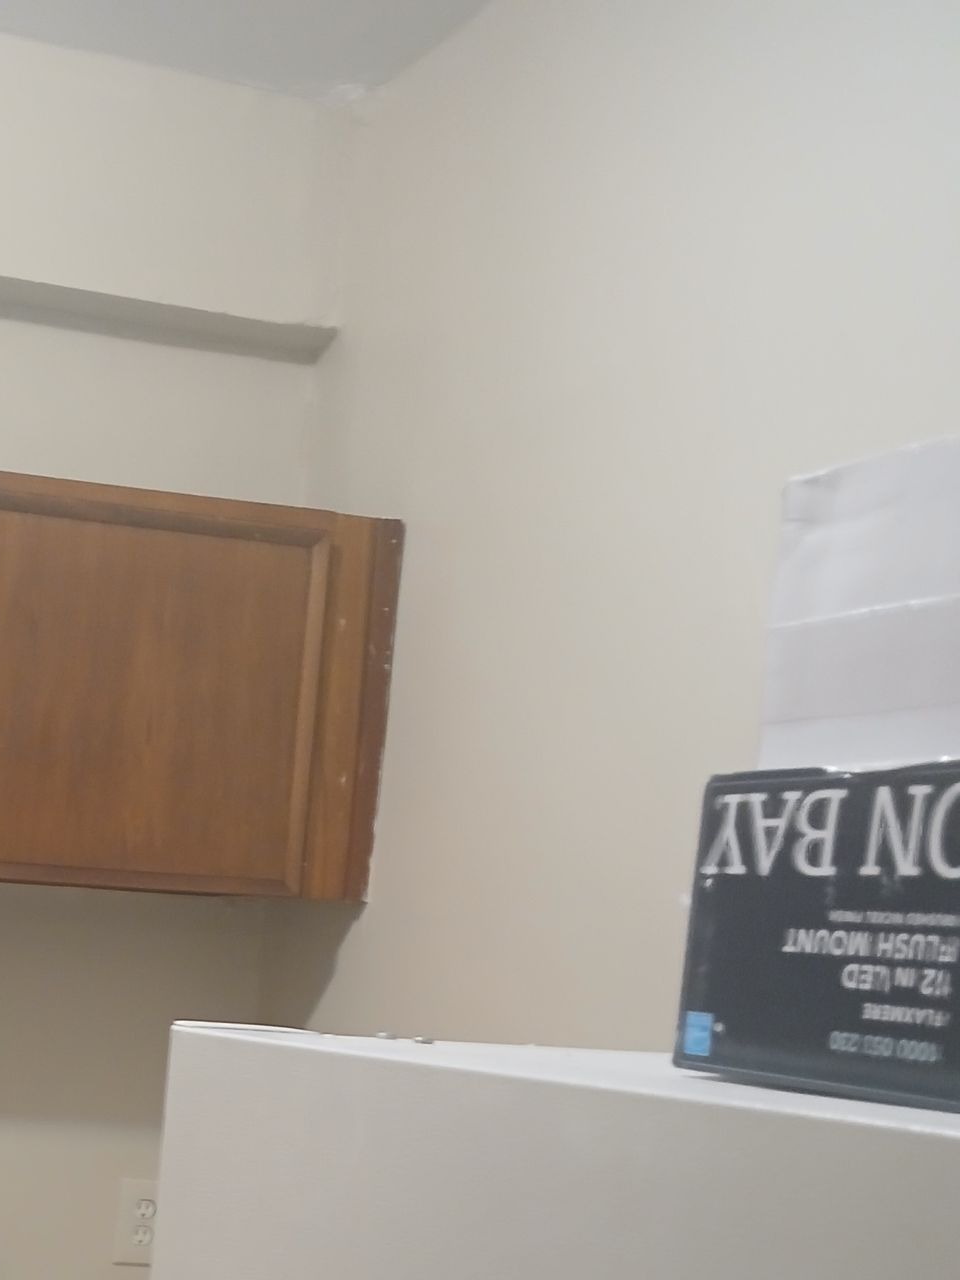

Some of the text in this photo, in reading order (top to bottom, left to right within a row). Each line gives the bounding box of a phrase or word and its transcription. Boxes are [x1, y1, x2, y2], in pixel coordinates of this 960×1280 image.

[700, 787, 848, 877] BAY
[782, 927, 959, 962] FLUSH MOUNT
[841, 963, 890, 994] LED
